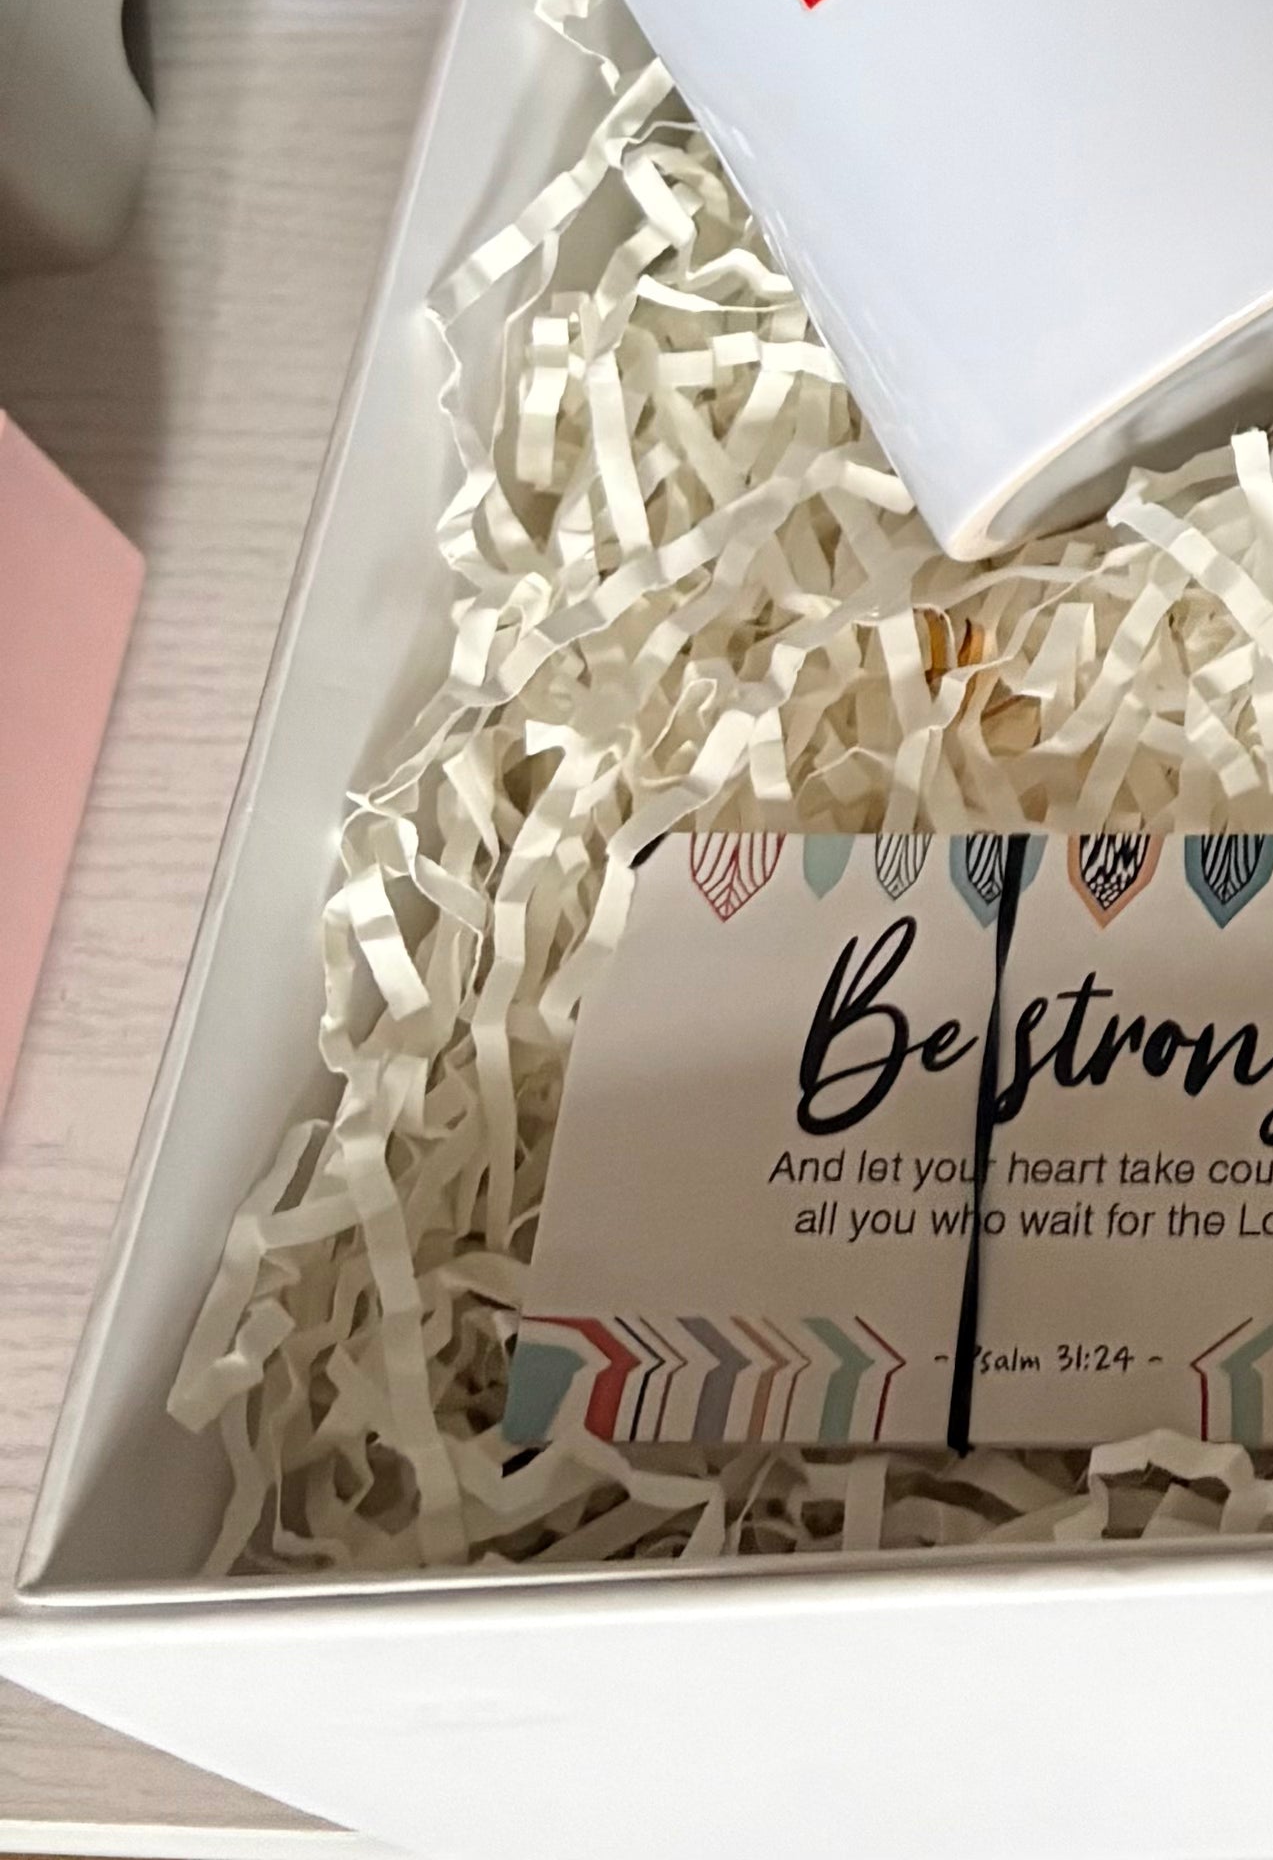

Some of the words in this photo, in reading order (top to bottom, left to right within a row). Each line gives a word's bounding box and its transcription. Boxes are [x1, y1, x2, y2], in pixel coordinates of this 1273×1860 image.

[796, 914, 979, 1138] Be
[767, 1148, 846, 1184] And
[857, 1149, 904, 1184] let
[1007, 1150, 1108, 1186] heart
[1119, 1150, 1195, 1186] take
[794, 1200, 838, 1236] all
[847, 1208, 917, 1244] you
[930, 1201, 1006, 1237] who
[1019, 1201, 1095, 1238] wait
[1106, 1202, 1157, 1239] for
[1167, 1201, 1226, 1239] the
[1057, 1343, 1135, 1373] 31:24
